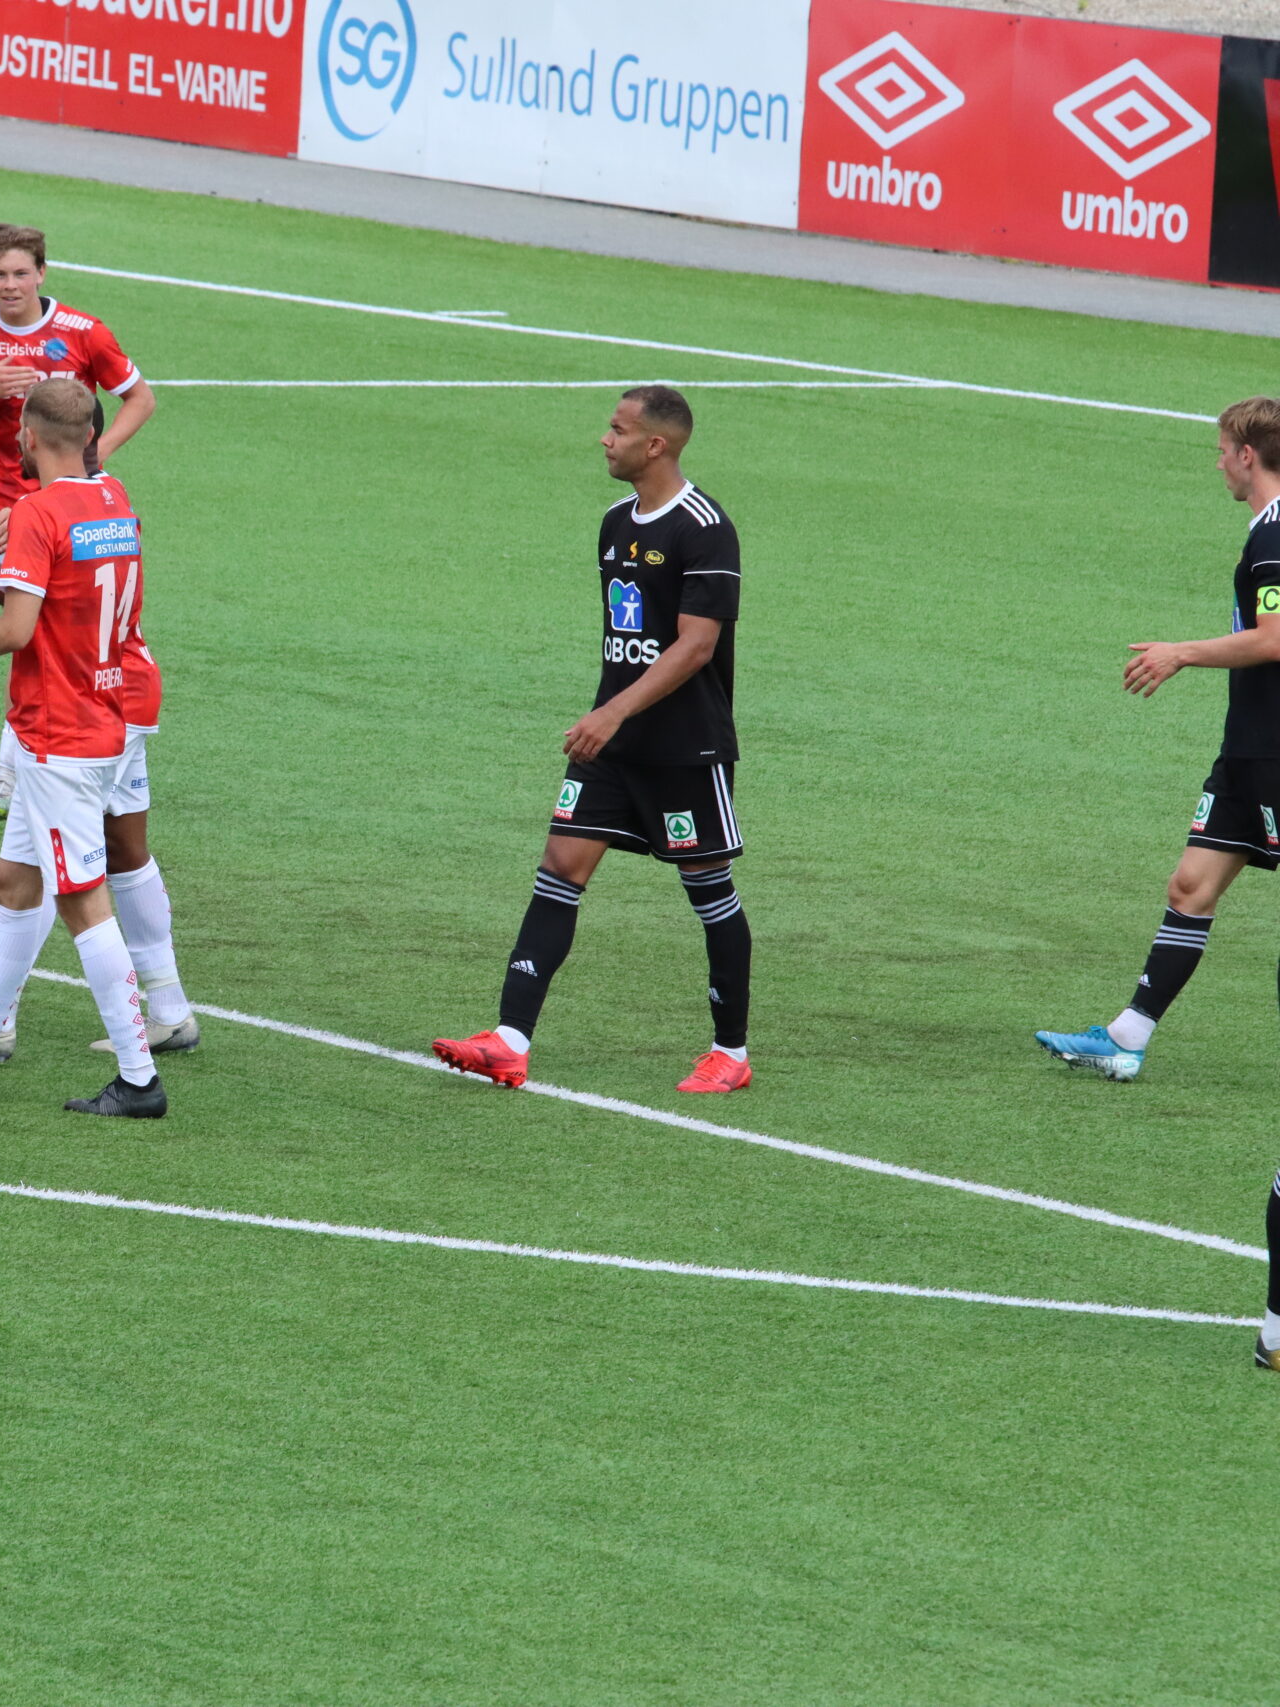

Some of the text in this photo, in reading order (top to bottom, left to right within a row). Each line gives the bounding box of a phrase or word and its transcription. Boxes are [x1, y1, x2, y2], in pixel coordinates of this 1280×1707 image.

[127, 52, 268, 112] EL-VARME
[335, 16, 402, 90] SG
[442, 31, 790, 155] Sulland Gruppen
[826, 155, 943, 212] umbro
[1061, 185, 1189, 243] umbro
[72, 521, 135, 546] SpareBank
[94, 561, 139, 664] 14
[604, 635, 661, 665] OBOS
[669, 840, 698, 849] SPAR
